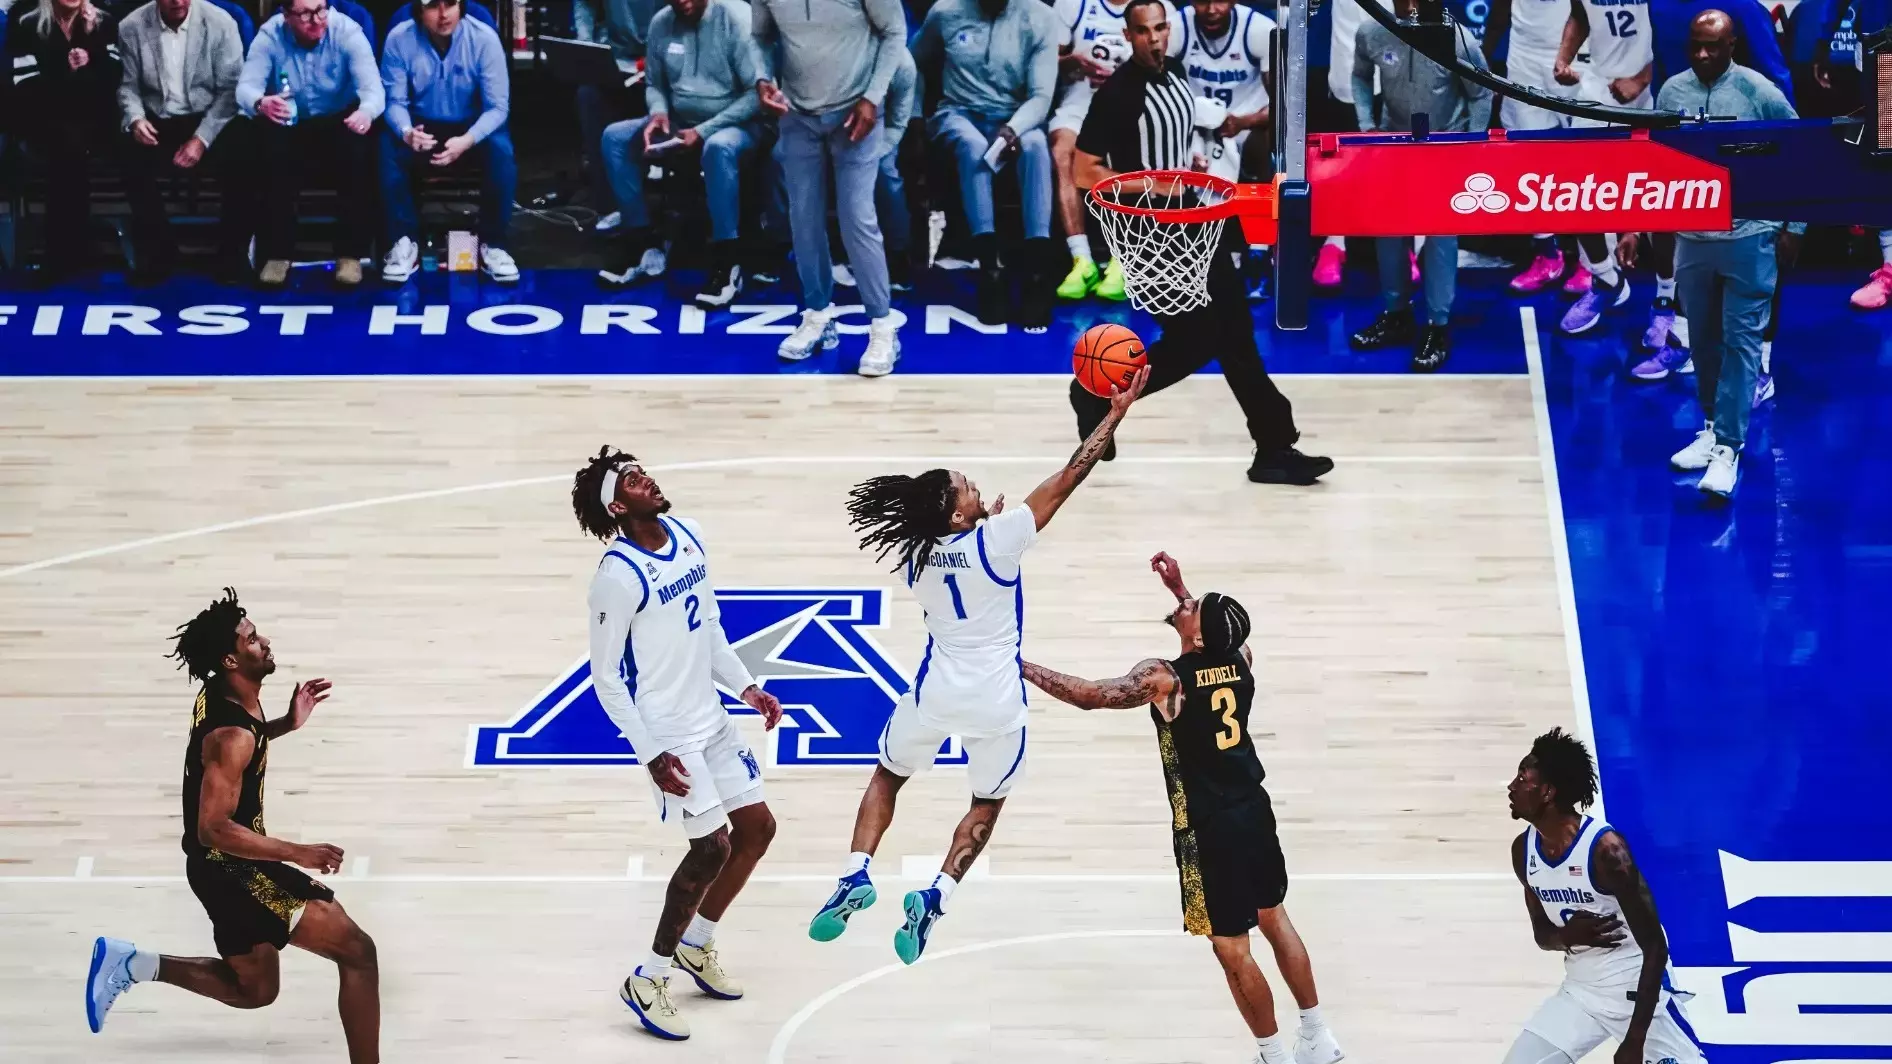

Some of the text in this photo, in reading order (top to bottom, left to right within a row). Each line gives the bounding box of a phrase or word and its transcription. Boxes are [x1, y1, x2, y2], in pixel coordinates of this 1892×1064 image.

[1605, 10, 1637, 38] 12
[1188, 63, 1249, 84] Memphis
[656, 562, 707, 606] Memphis
[943, 573, 968, 620] 1
[684, 593, 702, 632] 2
[1195, 664, 1242, 688] KINDELL
[1211, 688, 1242, 751] 3
